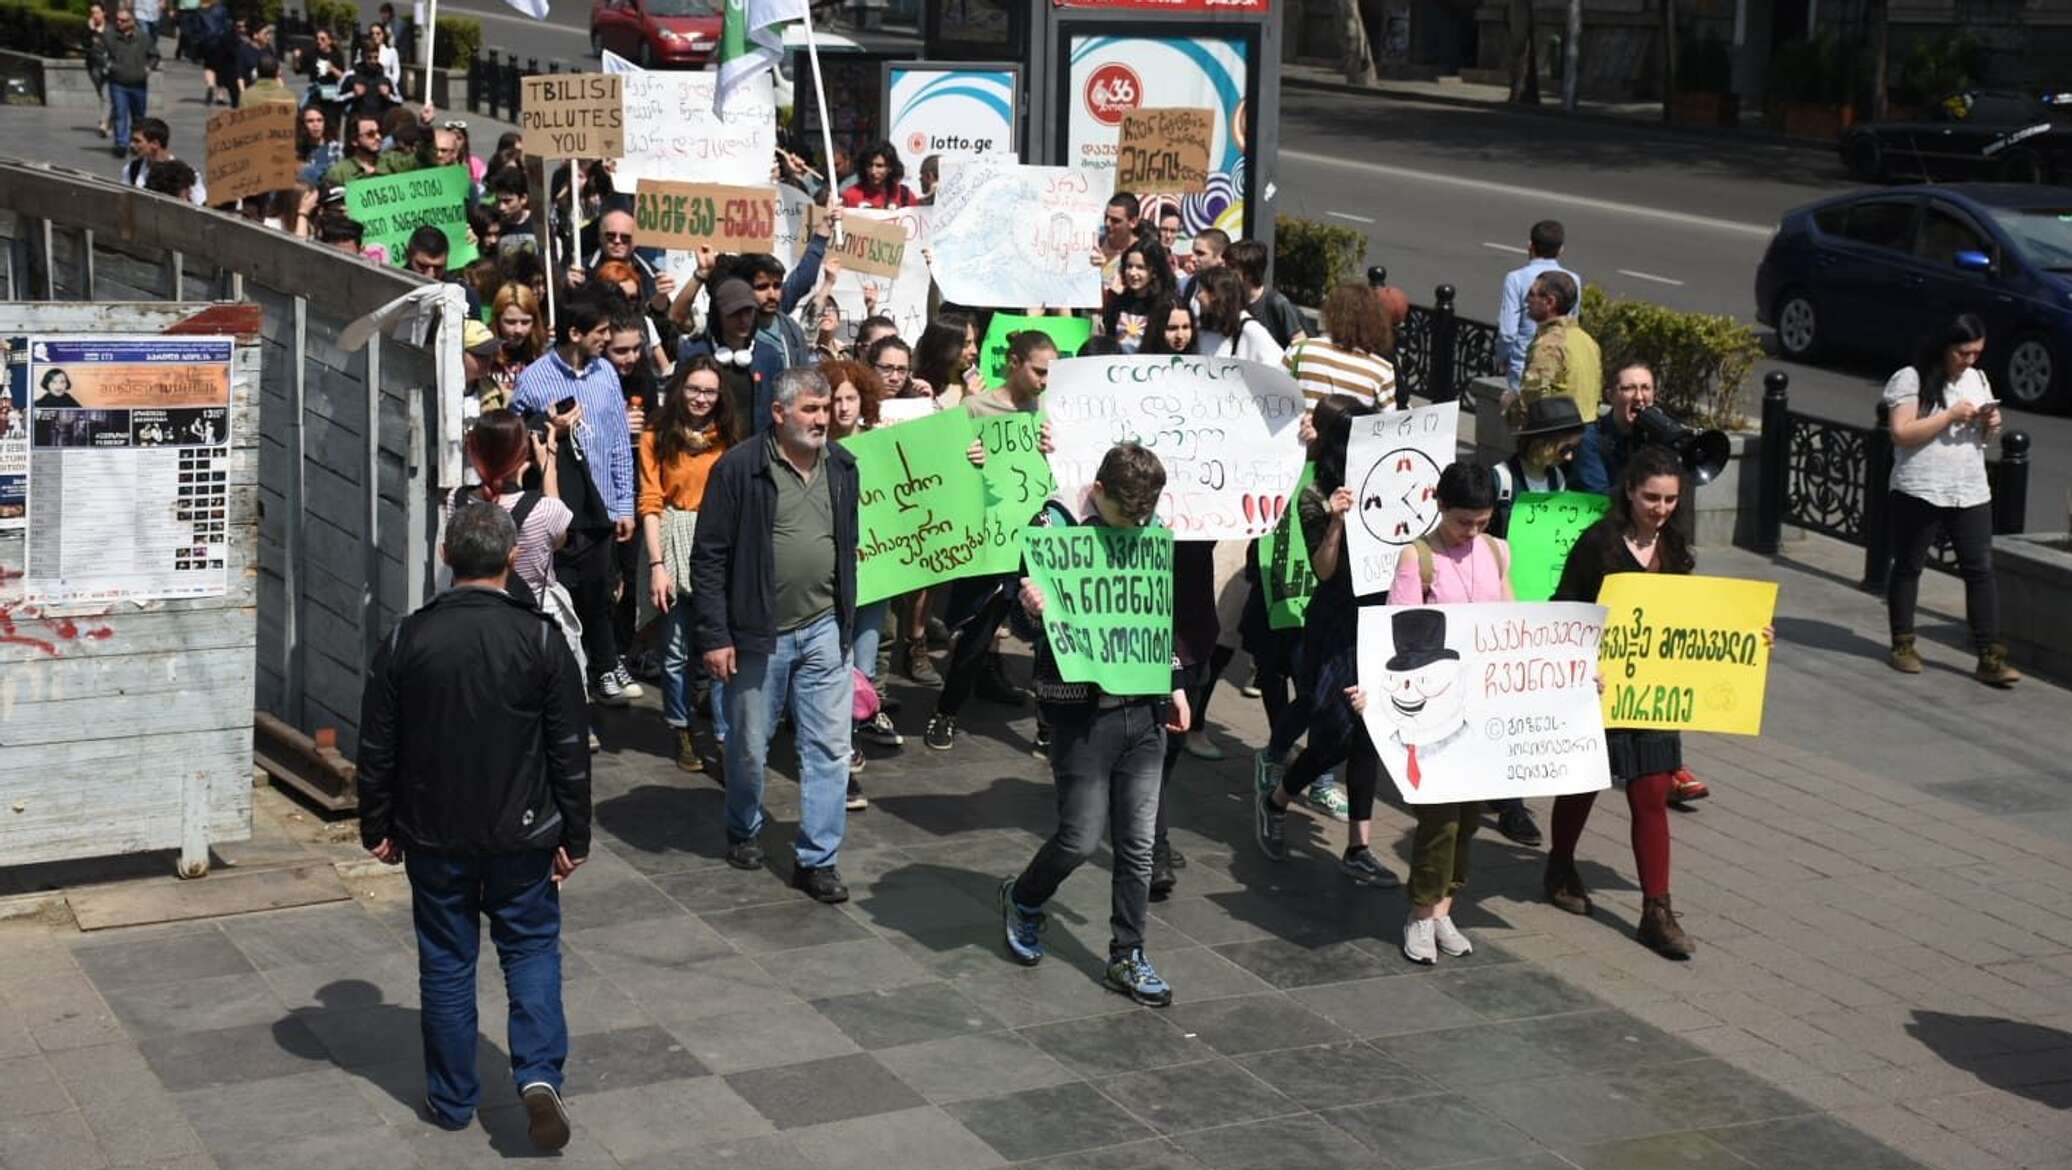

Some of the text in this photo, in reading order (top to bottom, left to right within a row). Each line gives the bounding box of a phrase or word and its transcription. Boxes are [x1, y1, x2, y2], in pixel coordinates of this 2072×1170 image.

[527, 78, 617, 101] TBILISI
[523, 107, 623, 130] POLLUTES
[551, 132, 588, 153] YOU
[930, 134, 993, 155] lotto.ge
[1474, 618, 1600, 653] საქართველო
